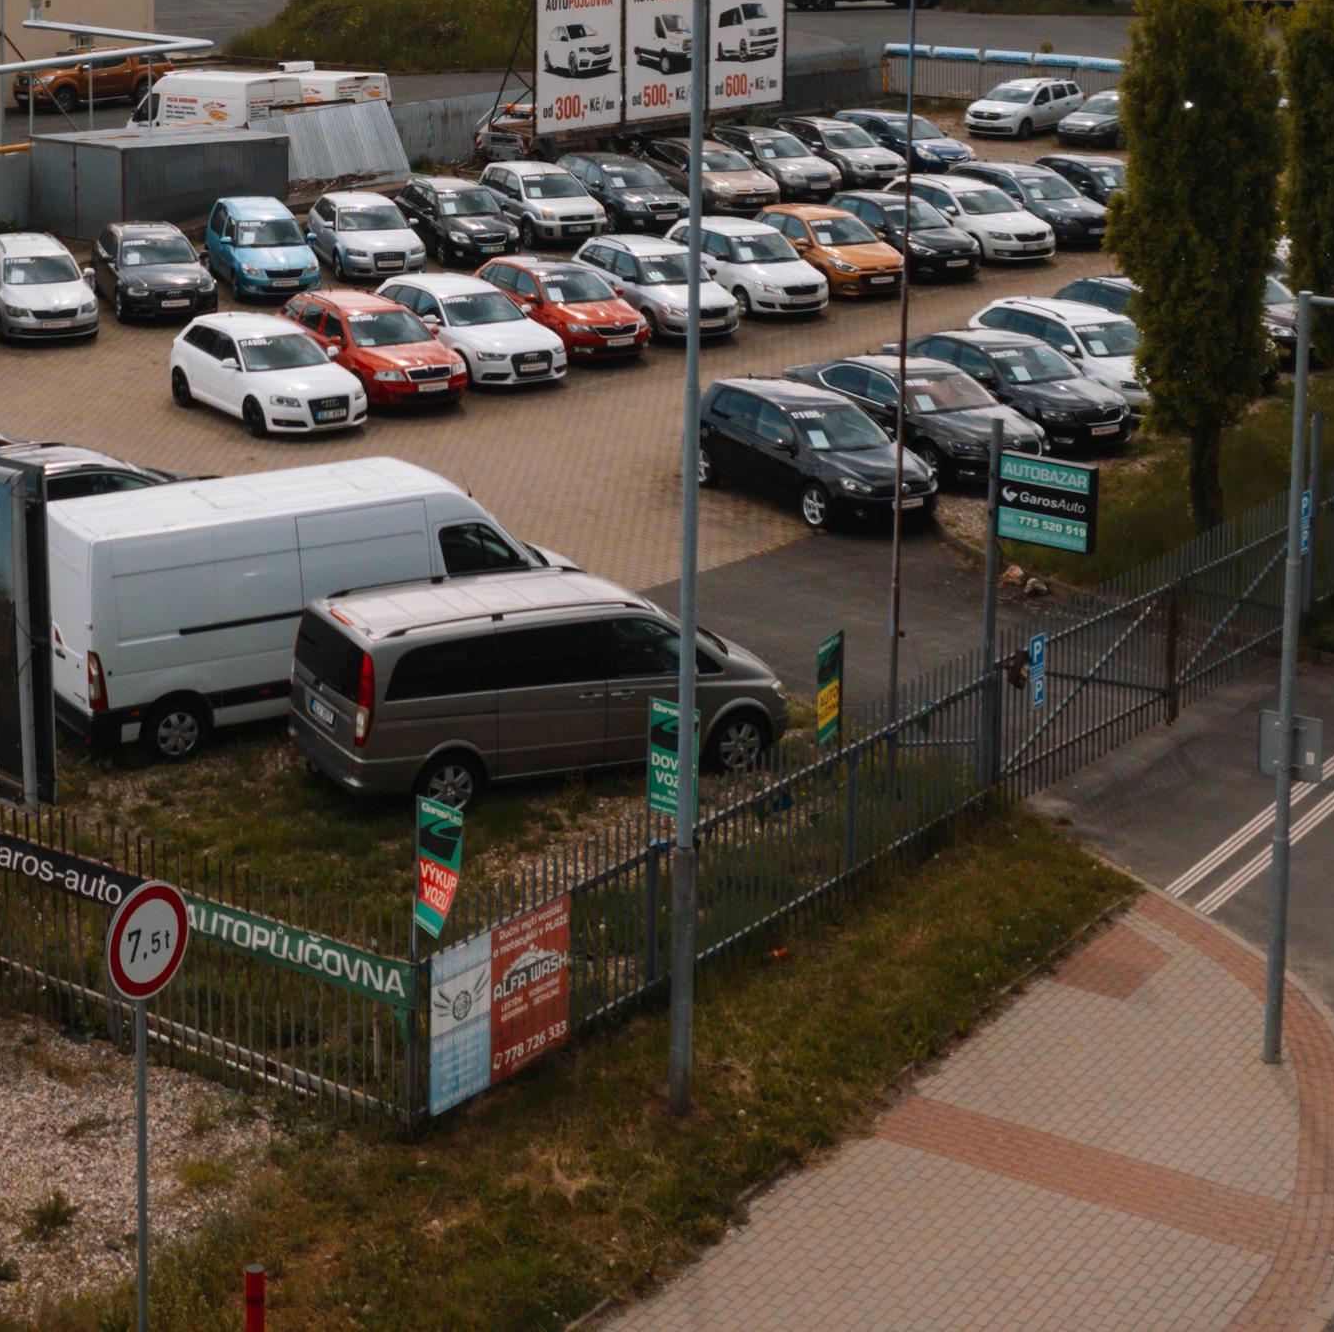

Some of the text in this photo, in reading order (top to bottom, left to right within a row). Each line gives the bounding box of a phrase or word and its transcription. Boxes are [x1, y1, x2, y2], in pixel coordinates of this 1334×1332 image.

[632, 92, 642, 107] od
[675, 85, 692, 100] Kč/
[714, 81, 724, 97] od
[543, 104, 554, 119] od
[1003, 461, 1088, 489] AUTOBAZAR
[1019, 491, 1086, 514] GarosAuto
[1018, 515, 1040, 528] 775
[1042, 520, 1063, 533] 520
[1065, 525, 1087, 538] 519
[651, 752, 679, 771] DOV
[655, 770, 679, 787] VOZ
[419, 860, 458, 892] VÝKUP
[423, 882, 451, 911] VOZŮ
[499, 919, 520, 942] Ruční
[187, 904, 406, 999] AUTOPŮJČOVNA
[494, 951, 568, 1003] ALFA WASH
[504, 1019, 568, 1065] 778 726 333
